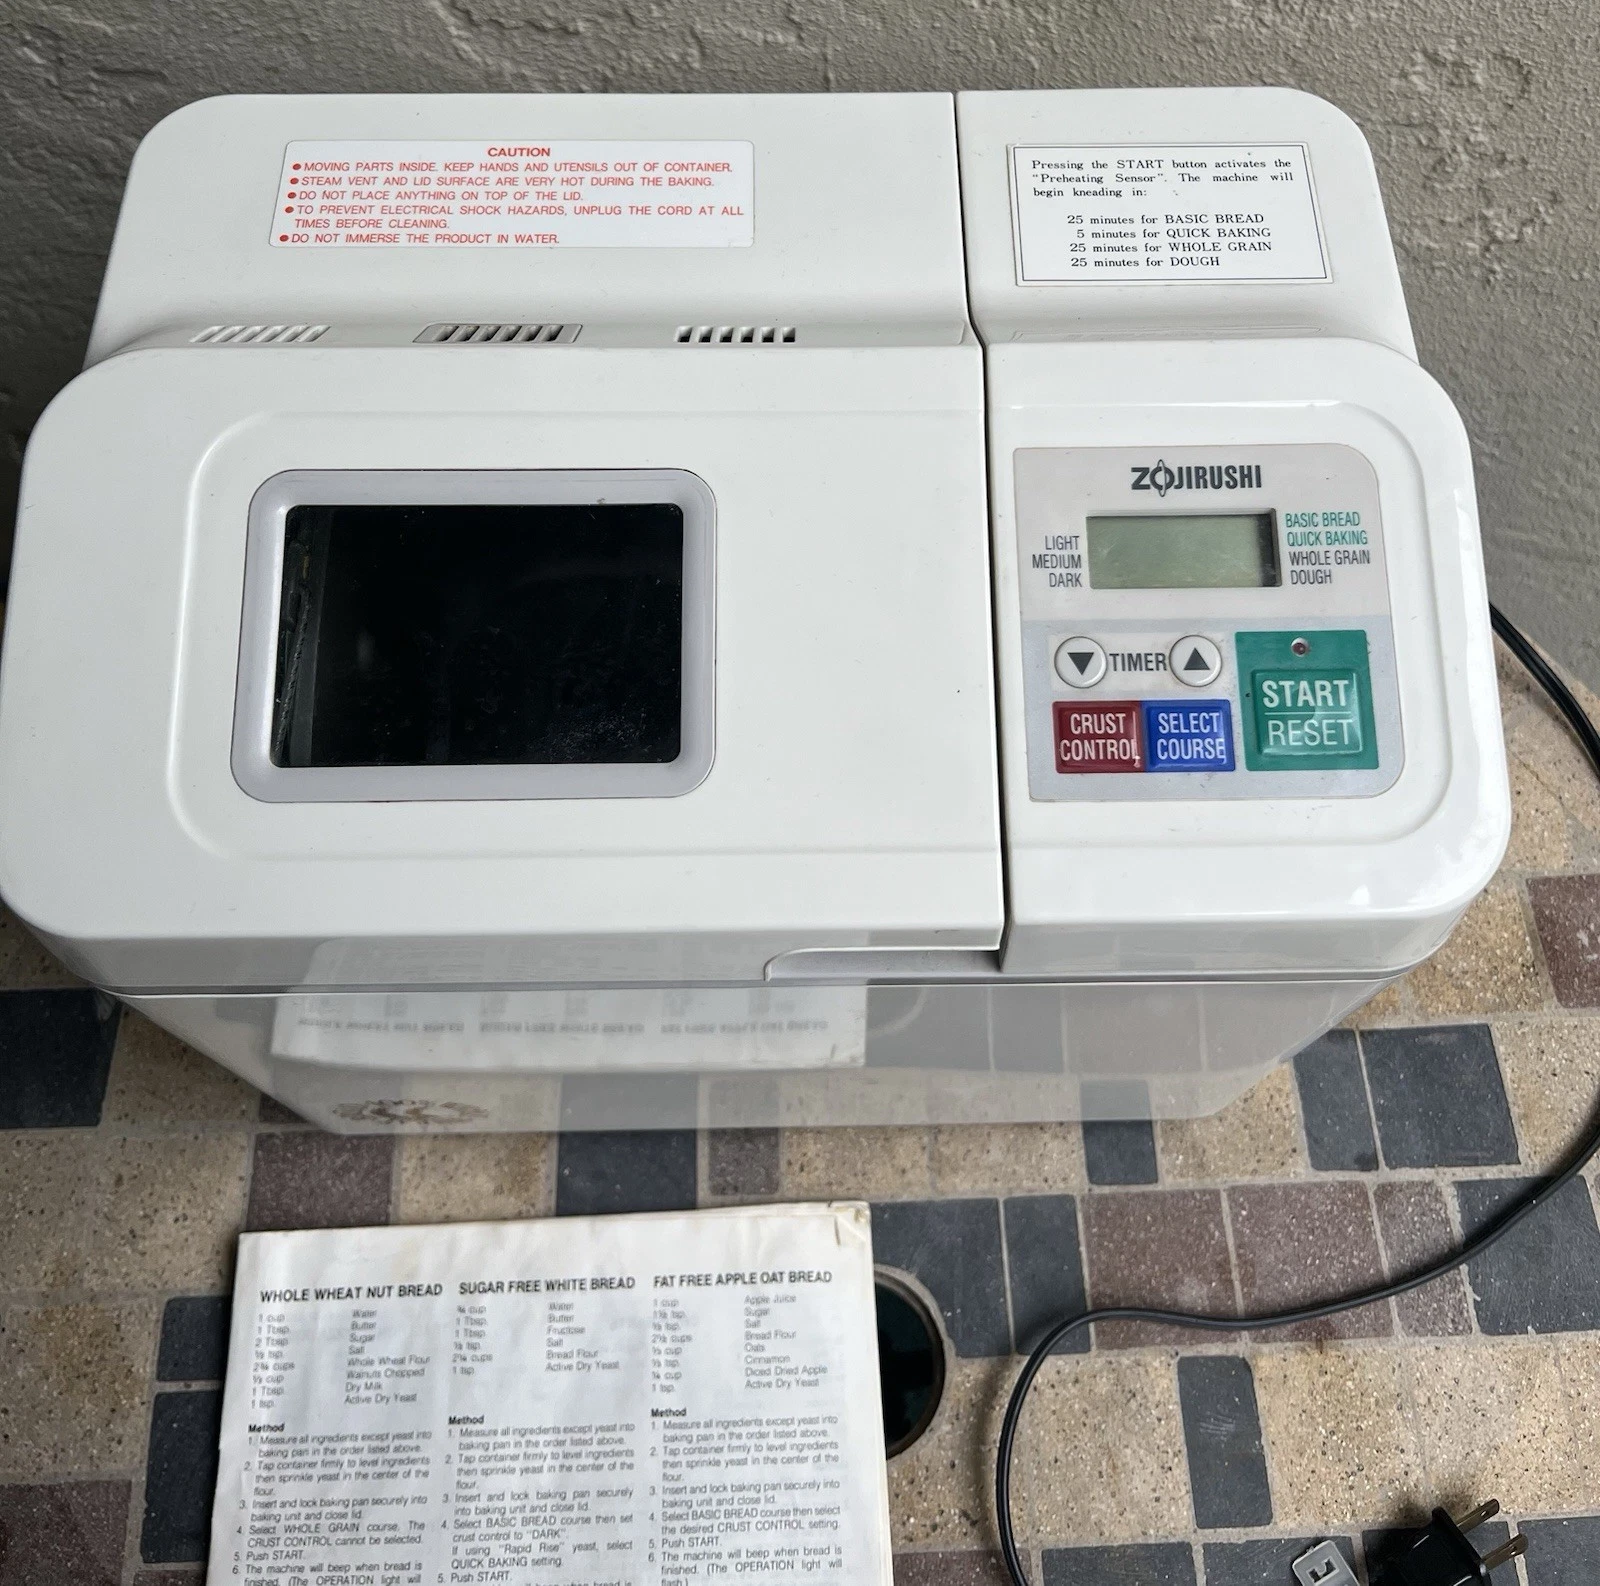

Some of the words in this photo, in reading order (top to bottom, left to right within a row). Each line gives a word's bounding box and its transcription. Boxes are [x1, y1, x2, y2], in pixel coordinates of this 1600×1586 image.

[488, 147, 550, 157] CAUTION
[304, 162, 350, 172] MOVING
[356, 162, 394, 172] PARTS
[444, 162, 474, 172] KEEP
[480, 162, 519, 172] HANDS
[524, 162, 549, 172] AND
[554, 162, 608, 172] UTENSILS
[614, 162, 638, 172] OUT
[643, 162, 659, 172] OF
[1032, 160, 1083, 170] Pressing
[1091, 160, 1108, 169] the
[1117, 159, 1164, 169] START
[1172, 160, 1207, 168] button
[1215, 160, 1266, 168] activates
[1274, 158, 1291, 167] the
[301, 176, 342, 186] STEAM
[348, 176, 378, 186] VENT
[383, 176, 408, 186] AND
[413, 176, 432, 186] LID
[437, 176, 490, 186] SURFACE
[495, 176, 519, 186] ARE
[525, 176, 555, 186] VERY
[561, 177, 585, 186] HOT
[591, 177, 634, 186] DURING
[640, 176, 662, 186] THE
[668, 177, 713, 186] BAKING.
[1178, 173, 1200, 182] The
[1213, 173, 1258, 182] machine
[1270, 172, 1293, 181] will
[299, 190, 317, 200] DO
[322, 190, 347, 200] NOT
[352, 190, 390, 200] PLACE
[395, 190, 456, 200] ANYTHING
[461, 191, 479, 201] ON
[484, 191, 508, 200] TOP
[513, 191, 529, 201] OF
[535, 191, 557, 201] THE
[563, 191, 583, 201] LID.
[1033, 187, 1064, 198] begin
[1073, 187, 1122, 198] kneading
[1132, 188, 1146, 196] in:
[297, 205, 314, 215] TO
[319, 205, 375, 215] PREVENT
[381, 205, 453, 215] ELECTRICAL
[460, 205, 501, 215] SHOCK
[508, 205, 567, 215] HAZARDS,
[574, 205, 622, 215] UNPLUG
[628, 205, 651, 215] THE
[657, 206, 692, 216] CORD
[698, 206, 715, 215] AT
[721, 206, 744, 216] ALL
[295, 218, 330, 229] TIMES
[336, 218, 383, 229] BEFORE
[388, 219, 449, 229] CLEANING.
[1067, 215, 1084, 224] 25
[1090, 215, 1134, 224] minutes
[1141, 214, 1158, 224] for
[1165, 214, 1208, 224] BASIC
[1215, 214, 1264, 223] BREAD
[292, 233, 310, 243] DO
[314, 233, 340, 243] NOT
[346, 233, 400, 243] IMMERSE
[406, 233, 429, 243] THE
[435, 234, 492, 244] PRODUCT
[497, 234, 509, 243] IN
[515, 234, 559, 244] WATER.
[1077, 229, 1085, 238] 5
[1091, 230, 1136, 238] minutes
[1143, 229, 1160, 238] for
[1166, 228, 1210, 239] QUICK
[1217, 228, 1270, 238] BAKING
[1070, 243, 1086, 252] 25
[1093, 244, 1138, 252] minutes
[1144, 243, 1162, 252] for
[1169, 242, 1221, 252] WHOLE
[1228, 242, 1271, 251] GRAIN
[1071, 257, 1087, 267] 25
[1094, 258, 1139, 267] minutes
[1146, 257, 1163, 267] for
[1170, 256, 1219, 266] DOUGH
[1131, 459, 1262, 497] ZOJIRUSHI
[1285, 512, 1319, 527] BASIC
[1322, 512, 1360, 526] BREAD
[1045, 535, 1080, 550] LIGHT
[1287, 532, 1323, 546] QUICK
[1325, 531, 1367, 545] BAKING
[1032, 554, 1082, 569] MEDIUM
[1289, 551, 1331, 565] WHOLE
[1334, 550, 1370, 564] GRAIN
[1049, 573, 1082, 588] DARK
[1290, 570, 1332, 584] DOUGH
[1109, 653, 1167, 672] TIMER
[1262, 680, 1349, 708] START
[1070, 713, 1126, 734] CRUST
[1158, 712, 1220, 734] SELECT
[1268, 720, 1353, 746] RESET
[1060, 739, 1140, 760] CONTROL
[1157, 738, 1225, 760] COURSE
[459, 1281, 504, 1295] SUGAR
[508, 1280, 540, 1292] FREE
[545, 1278, 586, 1291] WHITE
[591, 1277, 635, 1290] BREAD
[654, 1275, 675, 1288] FAT
[679, 1274, 712, 1286] FREE
[715, 1272, 757, 1285] APPLE
[760, 1272, 785, 1284] OAT
[788, 1271, 832, 1283] BREAD
[260, 1289, 308, 1302] WHOLE
[314, 1287, 362, 1300] WHEAT
[367, 1285, 393, 1298] NUT
[398, 1283, 442, 1297] BREAD
[651, 1408, 687, 1417] Method
[448, 1415, 484, 1425] Method
[248, 1424, 285, 1433] Method
[454, 1519, 482, 1529] Select
[486, 1516, 517, 1528] BASIC
[521, 1515, 557, 1527] BREAD
[560, 1516, 591, 1526] course
[595, 1515, 616, 1524] then
[620, 1513, 633, 1523] set
[662, 1511, 689, 1522] Select
[691, 1509, 721, 1521] BASIC
[723, 1508, 758, 1519] BREAD
[760, 1508, 791, 1518] course
[792, 1506, 813, 1517] then
[814, 1506, 840, 1516] select
[249, 1525, 276, 1535] Select
[284, 1524, 320, 1534] WHOLE
[328, 1522, 360, 1533] GRAIN
[409, 1521, 425, 1531] The
[661, 1526, 676, 1535] the
[680, 1523, 714, 1534] desired
[717, 1521, 751, 1534] CRUST
[755, 1520, 804, 1532] CONTROL
[247, 1536, 281, 1548] CRUST
[284, 1536, 332, 1548] CONTROL
[335, 1536, 366, 1546] cannot
[369, 1535, 381, 1545] be
[662, 1538, 685, 1548] Push
[246, 1551, 269, 1561] Push
[451, 1558, 484, 1570] QUICK
[488, 1556, 528, 1568] BAKING
[450, 1572, 474, 1583] Push
